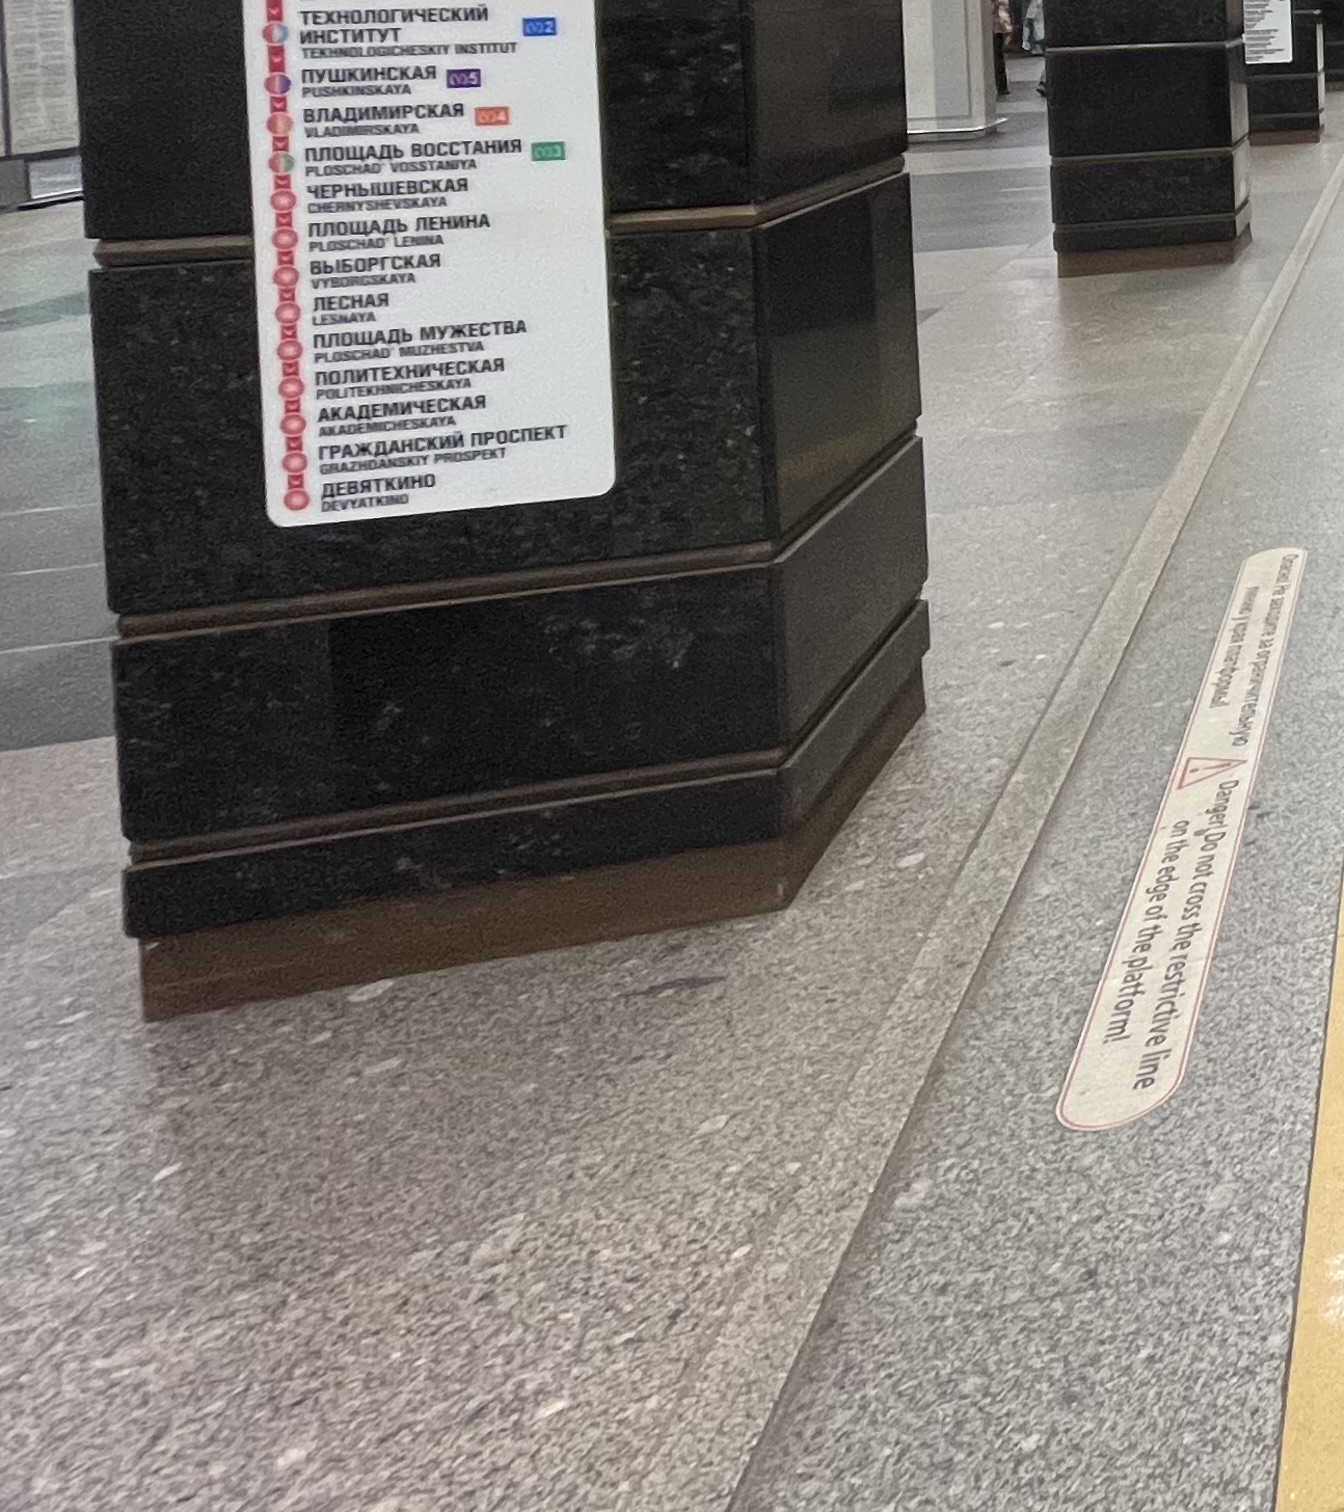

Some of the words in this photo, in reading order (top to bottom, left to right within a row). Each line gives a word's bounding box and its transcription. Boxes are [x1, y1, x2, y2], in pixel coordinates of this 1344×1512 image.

[300, 4, 489, 26] ТЕХНОЛОГИЧЕСКИЙ
[300, 28, 400, 43] ИНСТИТУТ
[302, 66, 437, 83] ПУШКИНСКАЯ
[303, 104, 465, 123] ВЛАДИМИРСКАЯ
[305, 145, 405, 162] ПЛОЩАДЬ
[411, 140, 522, 157] ВОССТАНИЯ
[307, 178, 469, 198] ЧЕРНЫШЕВСКАЯ
[309, 219, 408, 238] ПЛОЩАДЬ
[415, 214, 490, 231] ЛЕНИНА
[310, 254, 441, 275] ВЫБОРГСКАЯ
[313, 294, 389, 312] ЛЕСНАЯ
[313, 329, 412, 349] ПЛОЩАДЬ
[420, 320, 527, 340] МУЖЕСТВА
[316, 358, 505, 386] ПОЛИТЕХНИЧЕСКАЯ
[318, 396, 486, 422] АКАДЕМИЧЕСКАЯ
[318, 433, 465, 459] ГРАЖДАНСКИЙ
[471, 426, 568, 447] ПРОСПЕКТ
[322, 474, 436, 497] ДЕВЯТКИНО
[1204, 780, 1240, 831] Danger!
[1169, 820, 1190, 837] on
[1162, 840, 1189, 863] the
[1200, 832, 1227, 852] Do
[1193, 856, 1215, 879] not
[1146, 866, 1179, 902] edge
[1182, 882, 1207, 920] cross
[1144, 906, 1168, 921] of
[1132, 924, 1163, 953] the
[1169, 923, 1202, 952] the
[1103, 956, 1152, 1043] platform!
[1145, 954, 1188, 1047] restrictive
[1132, 1049, 1172, 1089] line
